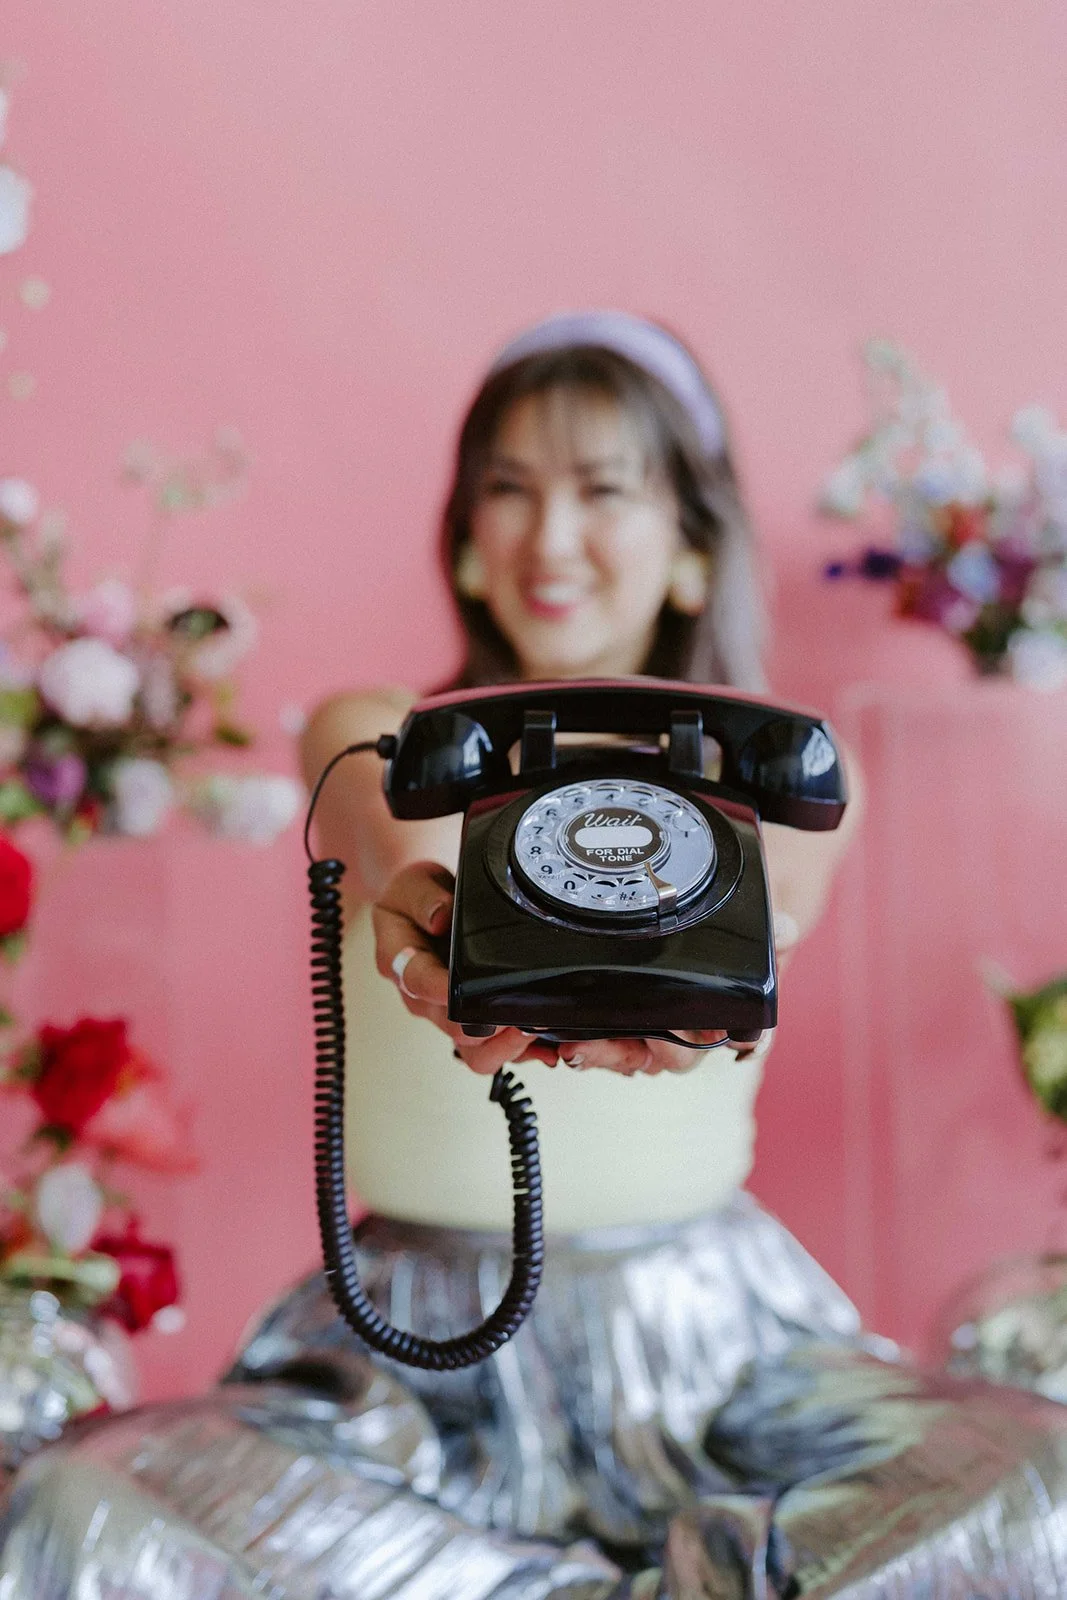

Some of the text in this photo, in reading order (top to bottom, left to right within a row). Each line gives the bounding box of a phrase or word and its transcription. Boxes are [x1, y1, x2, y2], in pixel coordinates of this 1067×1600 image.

[584, 813, 642, 827] Wait
[532, 826, 544, 835] 7
[530, 846, 542, 856] 8
[586, 847, 645, 857] FOR DIAL
[599, 855, 634, 863] TONE
[540, 864, 553, 875] 9
